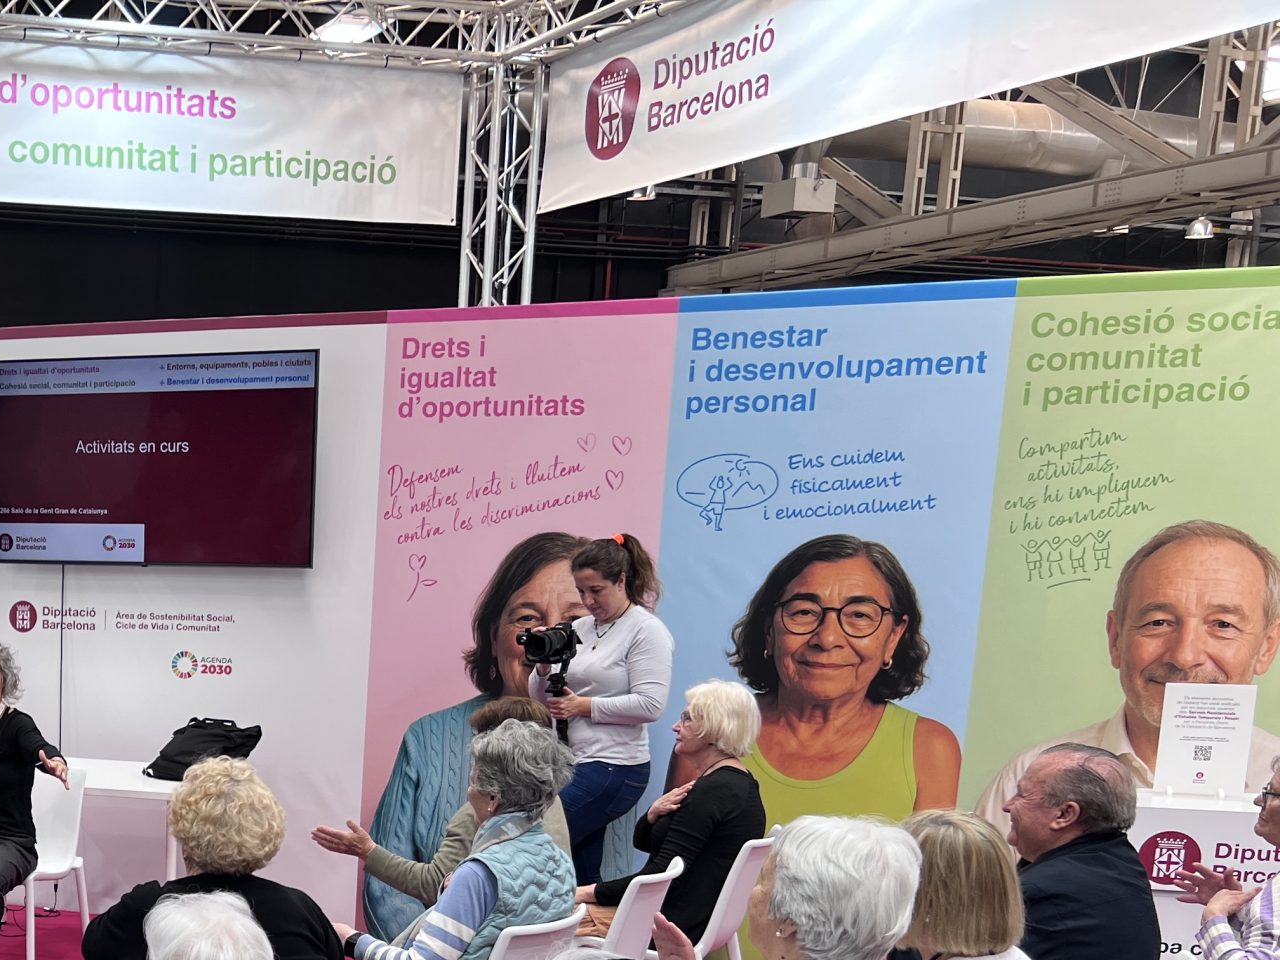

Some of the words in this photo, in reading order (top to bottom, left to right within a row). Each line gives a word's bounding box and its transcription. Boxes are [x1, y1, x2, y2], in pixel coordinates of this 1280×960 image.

[653, 18, 776, 91] Diputació
[647, 74, 769, 133] Barcelona
[8, 139, 180, 173] comunitat
[190, 145, 198, 174] i
[209, 150, 397, 187] participació
[1031, 307, 1175, 338] Cohesió
[401, 337, 470, 360] Drets
[479, 335, 486, 358] i
[691, 325, 828, 351] Benestar
[0, 368, 17, 376] Drets
[23, 367, 49, 376] igualtat
[166, 363, 197, 371] Entorns,
[200, 361, 250, 370] equipaments,
[252, 359, 278, 369] pobles
[285, 359, 312, 367] ciutats
[688, 360, 696, 382] i
[705, 350, 987, 383] desenvolupament
[1026, 343, 1203, 373] comunitat
[0, 382, 27, 390] Cohesió
[29, 382, 51, 391] social,
[53, 381, 88, 389] comunitat
[93, 379, 136, 389] participació
[166, 377, 199, 386] Benestar
[206, 375, 273, 384] desenvolupament
[275, 374, 310, 383] personal
[399, 365, 497, 395] igualtat
[1022, 381, 1032, 406] i
[1042, 374, 1250, 412] participació
[685, 388, 816, 420] personal
[75, 439, 135, 454] Activitats
[139, 442, 156, 453] en
[160, 441, 189, 453] curs
[1019, 428, 1128, 460] Compartim
[788, 454, 825, 470] Ens
[831, 449, 905, 467] cuidem
[1027, 452, 1120, 483] activitats,
[383, 496, 403, 521] els
[410, 487, 459, 515] nostres
[465, 472, 503, 501] drets
[525, 455, 586, 486] lluitem
[387, 464, 463, 499] Defensem
[1004, 494, 1038, 511] ens
[1043, 485, 1064, 504] hi
[1069, 473, 1175, 502] impliquem
[397, 517, 445, 545] contra
[453, 507, 473, 532] les
[480, 485, 601, 526] discriminacions
[763, 506, 770, 520] i
[776, 494, 937, 520] emocionalment
[1022, 511, 1043, 531] hi
[1048, 497, 1157, 528] connectem
[42, 620, 96, 631] Barcelona
[116, 621, 136, 630] Cicle
[138, 622, 149, 630] de
[151, 623, 169, 631] Vida
[176, 624, 220, 632] Comunitat
[43, 607, 96, 618] Diputació
[137, 612, 147, 620] de
[149, 613, 205, 622] Sostenibilitat
[207, 614, 236, 624] Social,
[200, 664, 233, 675] 2030
